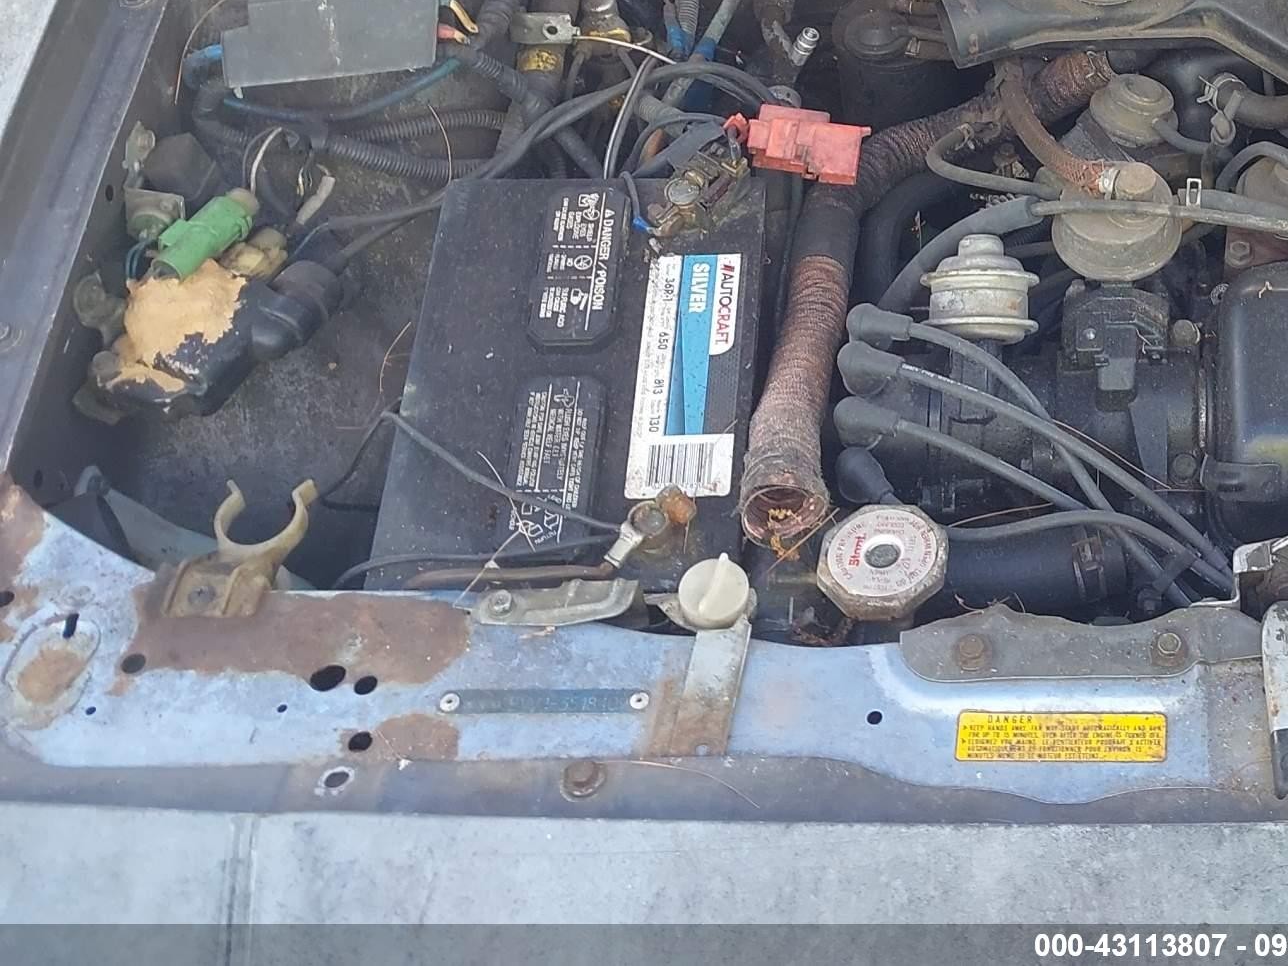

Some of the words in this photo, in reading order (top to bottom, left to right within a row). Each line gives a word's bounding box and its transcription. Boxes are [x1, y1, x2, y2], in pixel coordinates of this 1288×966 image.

[598, 218, 614, 260] DANGER
[592, 270, 607, 310] POISON
[688, 263, 710, 313] SILVER
[715, 273, 735, 344] AUTOCRAFT
[657, 331, 671, 350] 650
[652, 378, 665, 395] 813
[649, 416, 661, 433] 130
[987, 715, 1033, 724] DANGER
